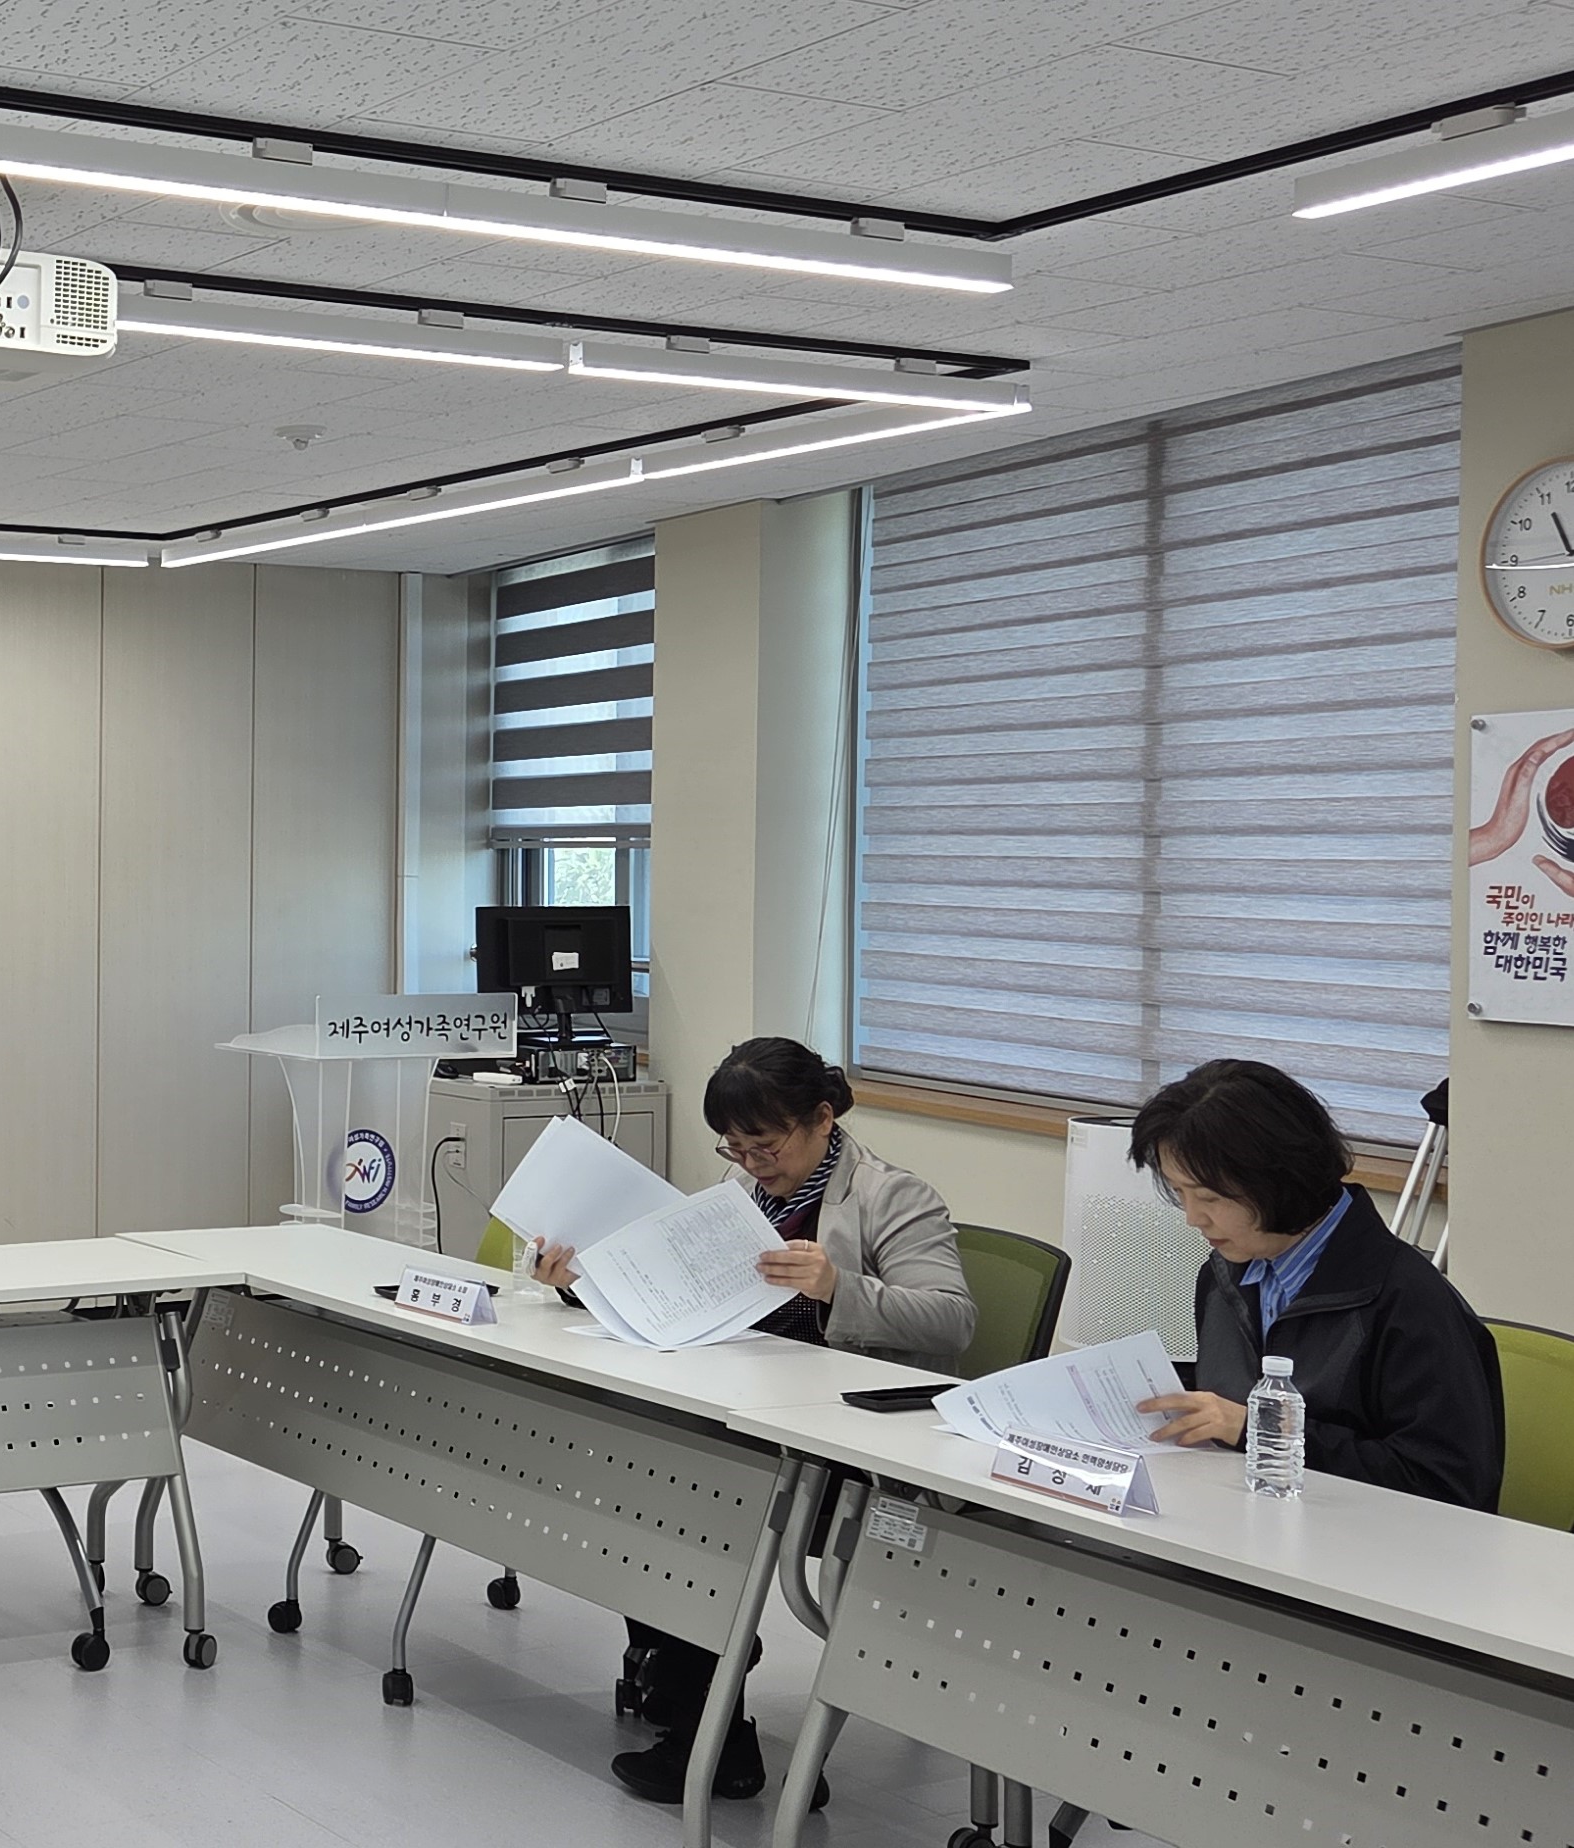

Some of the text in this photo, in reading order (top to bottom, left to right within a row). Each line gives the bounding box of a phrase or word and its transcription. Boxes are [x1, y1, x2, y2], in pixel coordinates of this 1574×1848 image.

[1539, 492, 1552, 505] 11
[1518, 518, 1532, 531] 10
[1509, 554, 1519, 567] 9
[1517, 586, 1527, 599] 8
[1537, 609, 1546, 623] 7
[1566, 614, 1574, 627] 6
[1486, 885, 1535, 910] 국민이
[1501, 912, 1574, 931] 주인인 나라
[1483, 930, 1568, 955] 함께 행복한
[1494, 953, 1568, 982] 대한민국
[328, 1012, 508, 1044] 제주여성가족연구원
